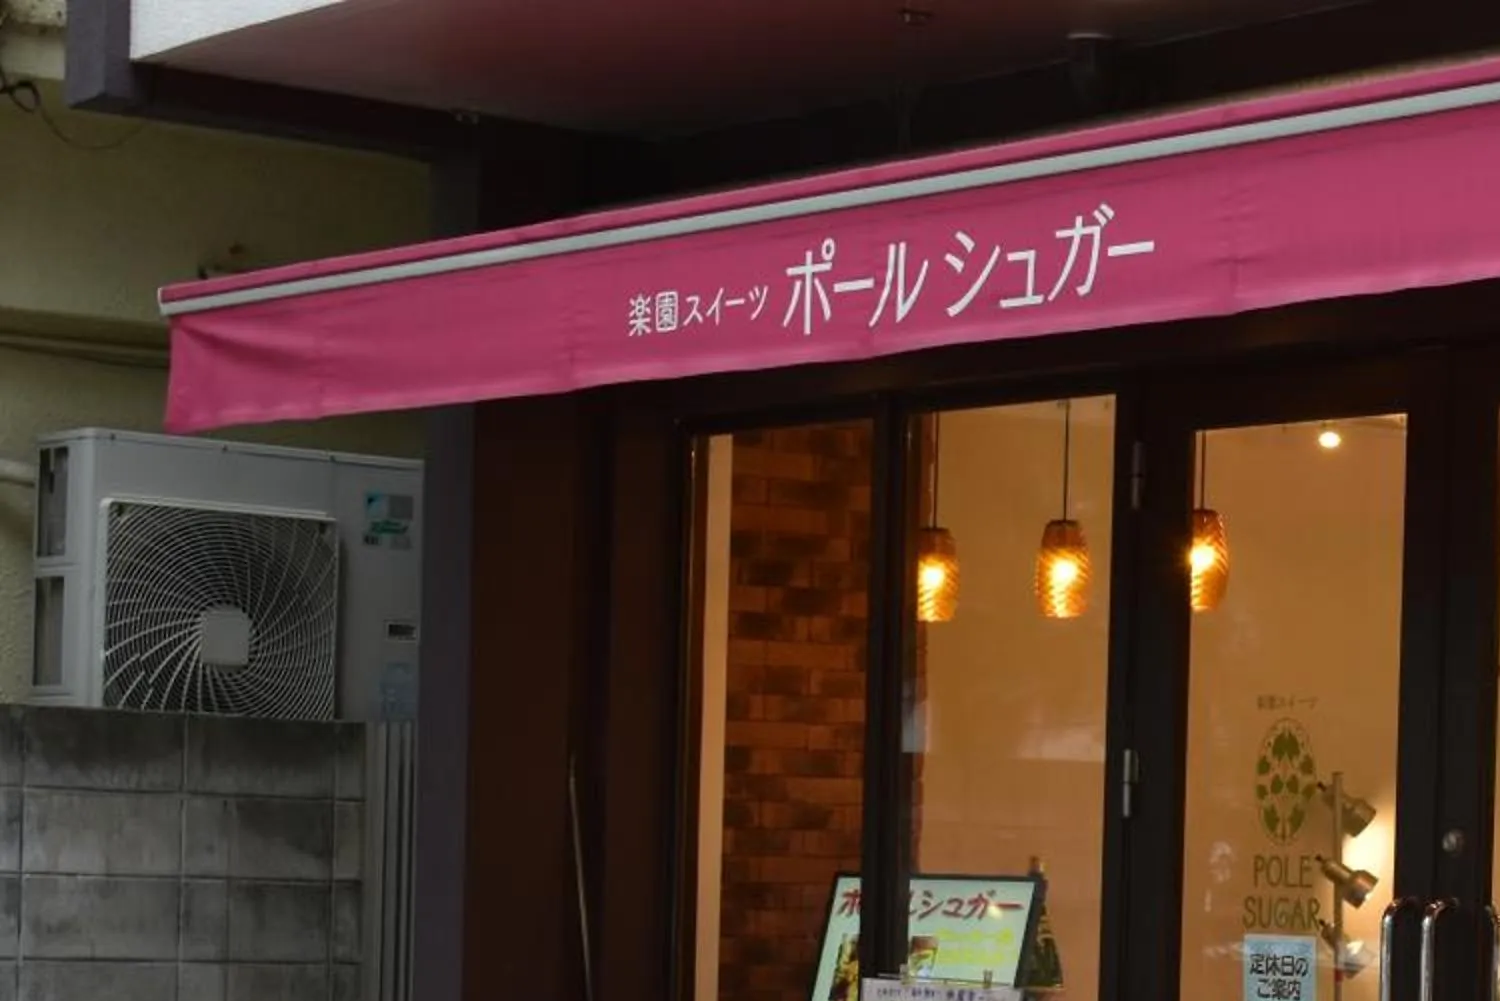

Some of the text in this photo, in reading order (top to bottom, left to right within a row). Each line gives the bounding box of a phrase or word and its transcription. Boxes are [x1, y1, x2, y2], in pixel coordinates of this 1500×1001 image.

[628, 203, 1156, 337] 楽園スイーツ ポールシュガー
[1253, 854, 1314, 890] POLE
[1242, 895, 1320, 931] SUGAR
[1249, 953, 1309, 978] 定休日の
[1256, 977, 1302, 1001] ご案内
